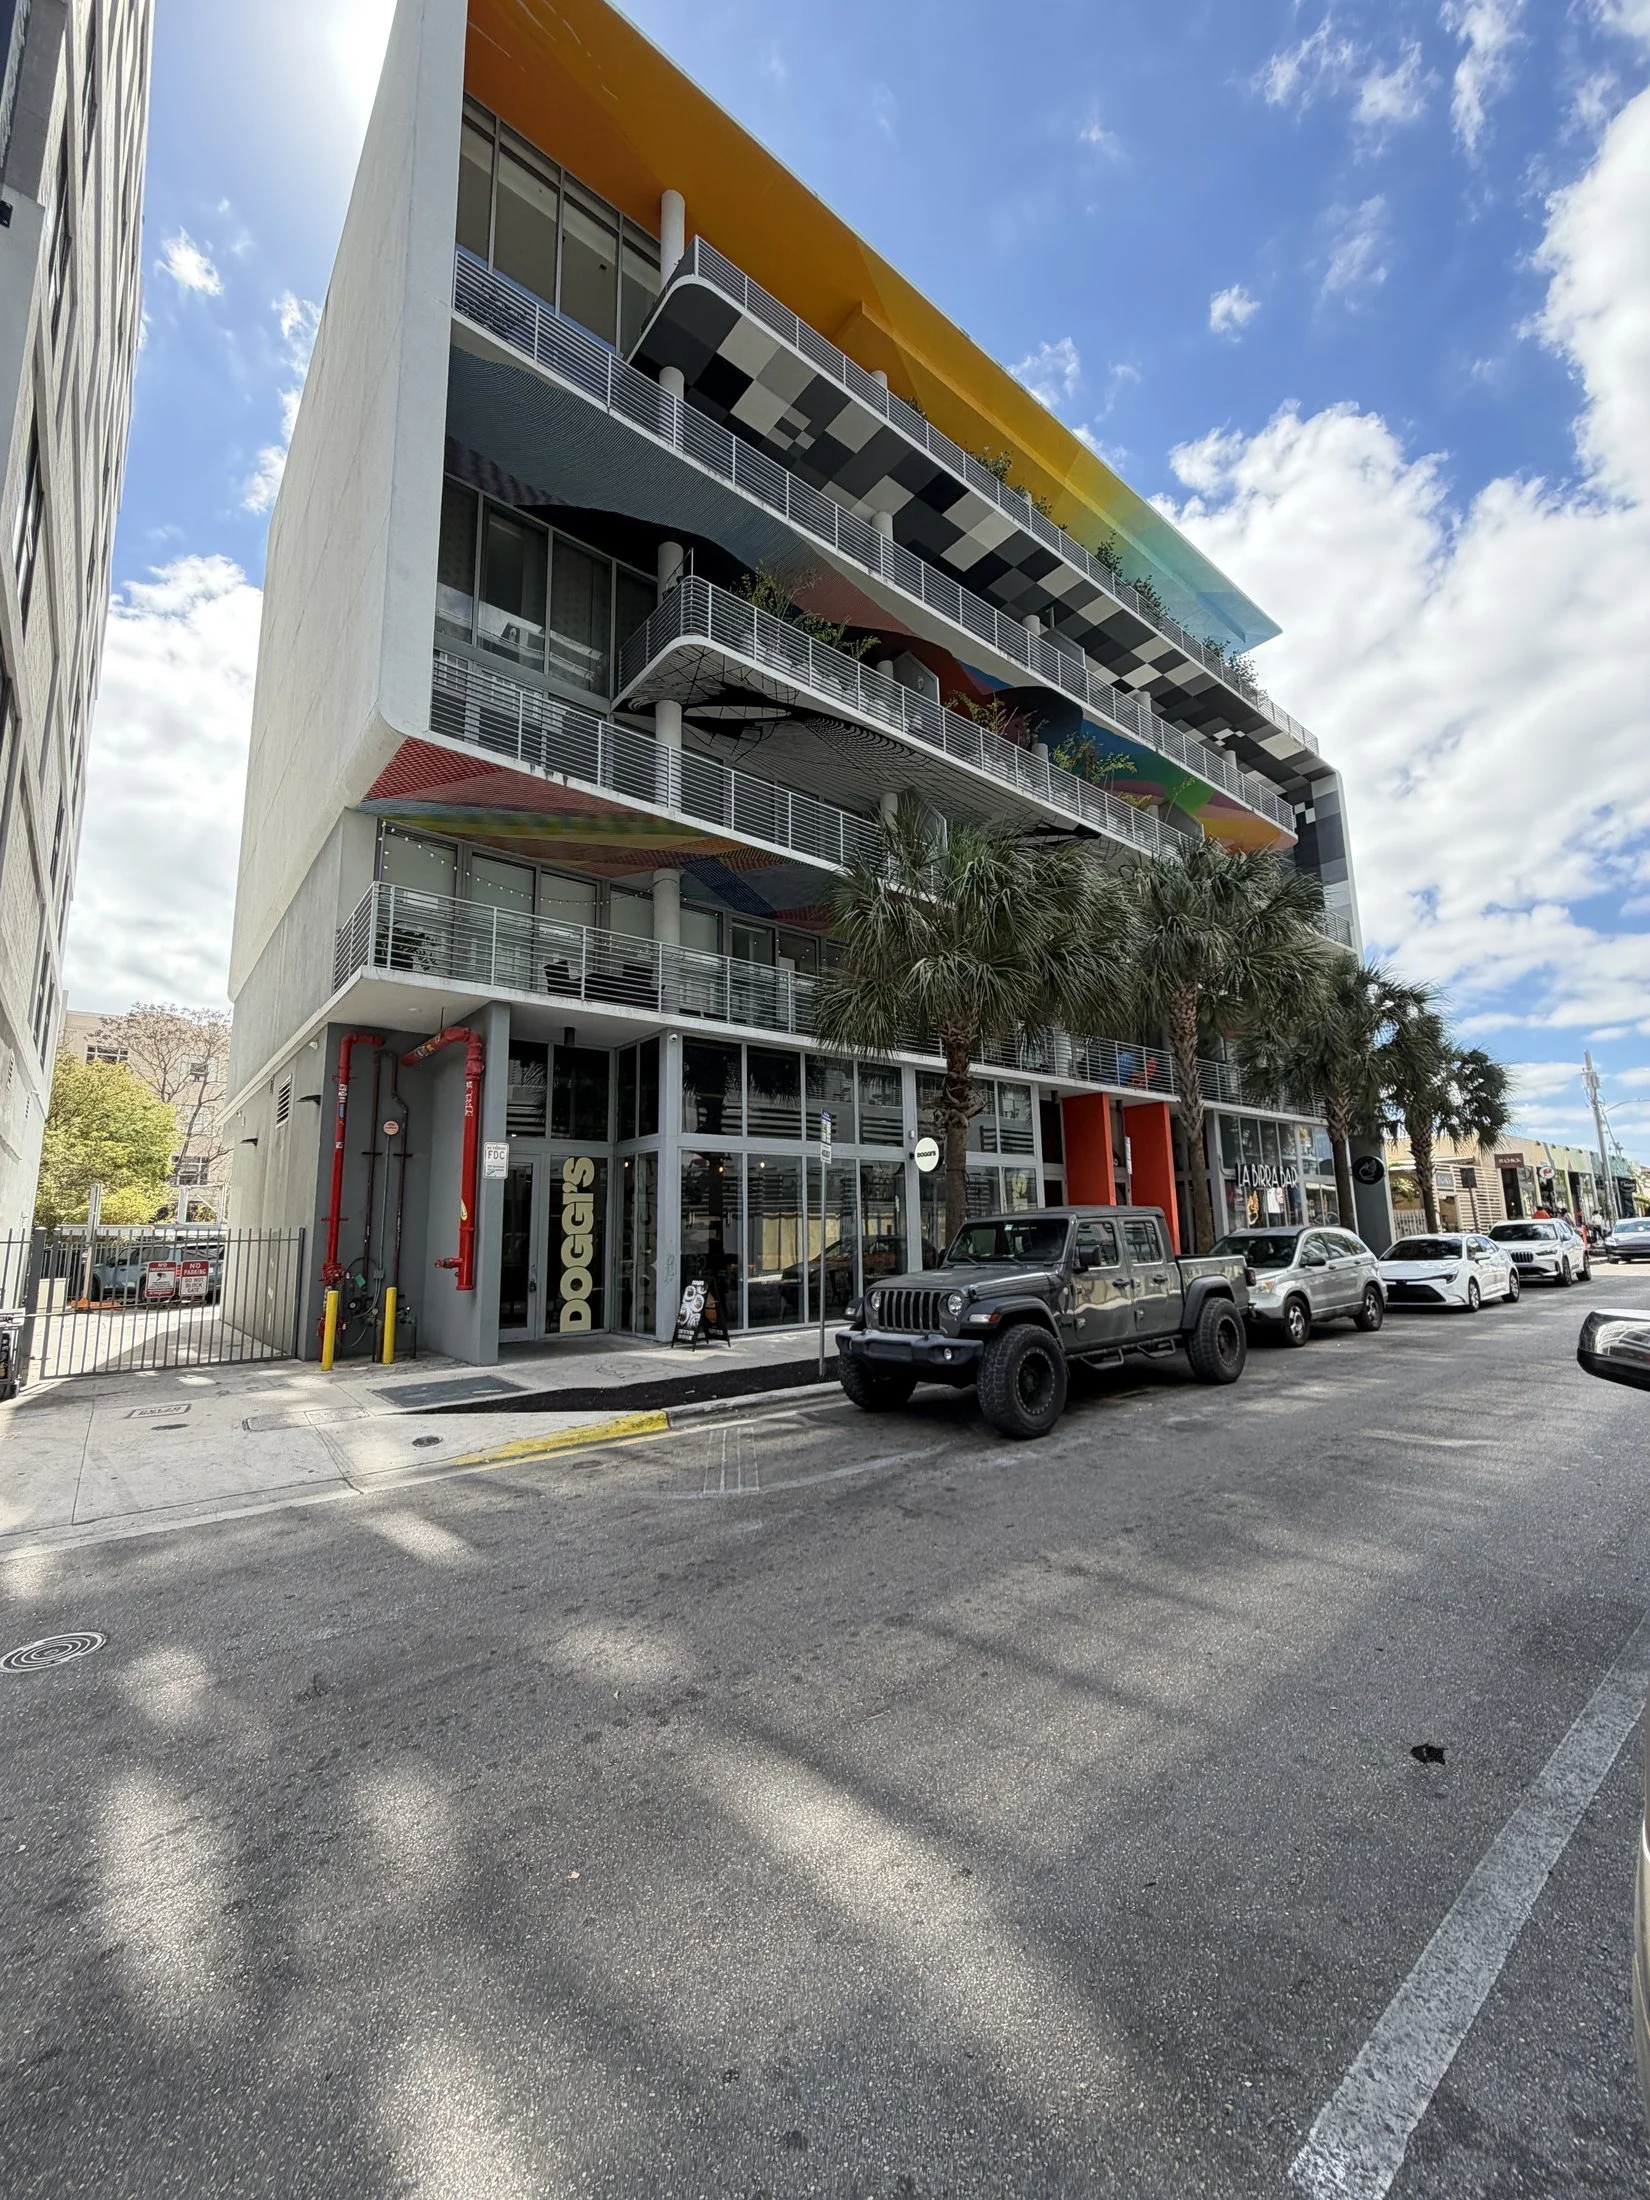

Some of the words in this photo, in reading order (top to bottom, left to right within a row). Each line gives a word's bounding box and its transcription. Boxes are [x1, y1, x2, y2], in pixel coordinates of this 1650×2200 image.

[487, 1150, 505, 1160] FDC
[1237, 1162, 1251, 1187] LA
[1251, 1163, 1280, 1188] BIRRA
[1280, 1166, 1298, 1188] BAR
[560, 1157, 595, 1332] DOGGI'S
